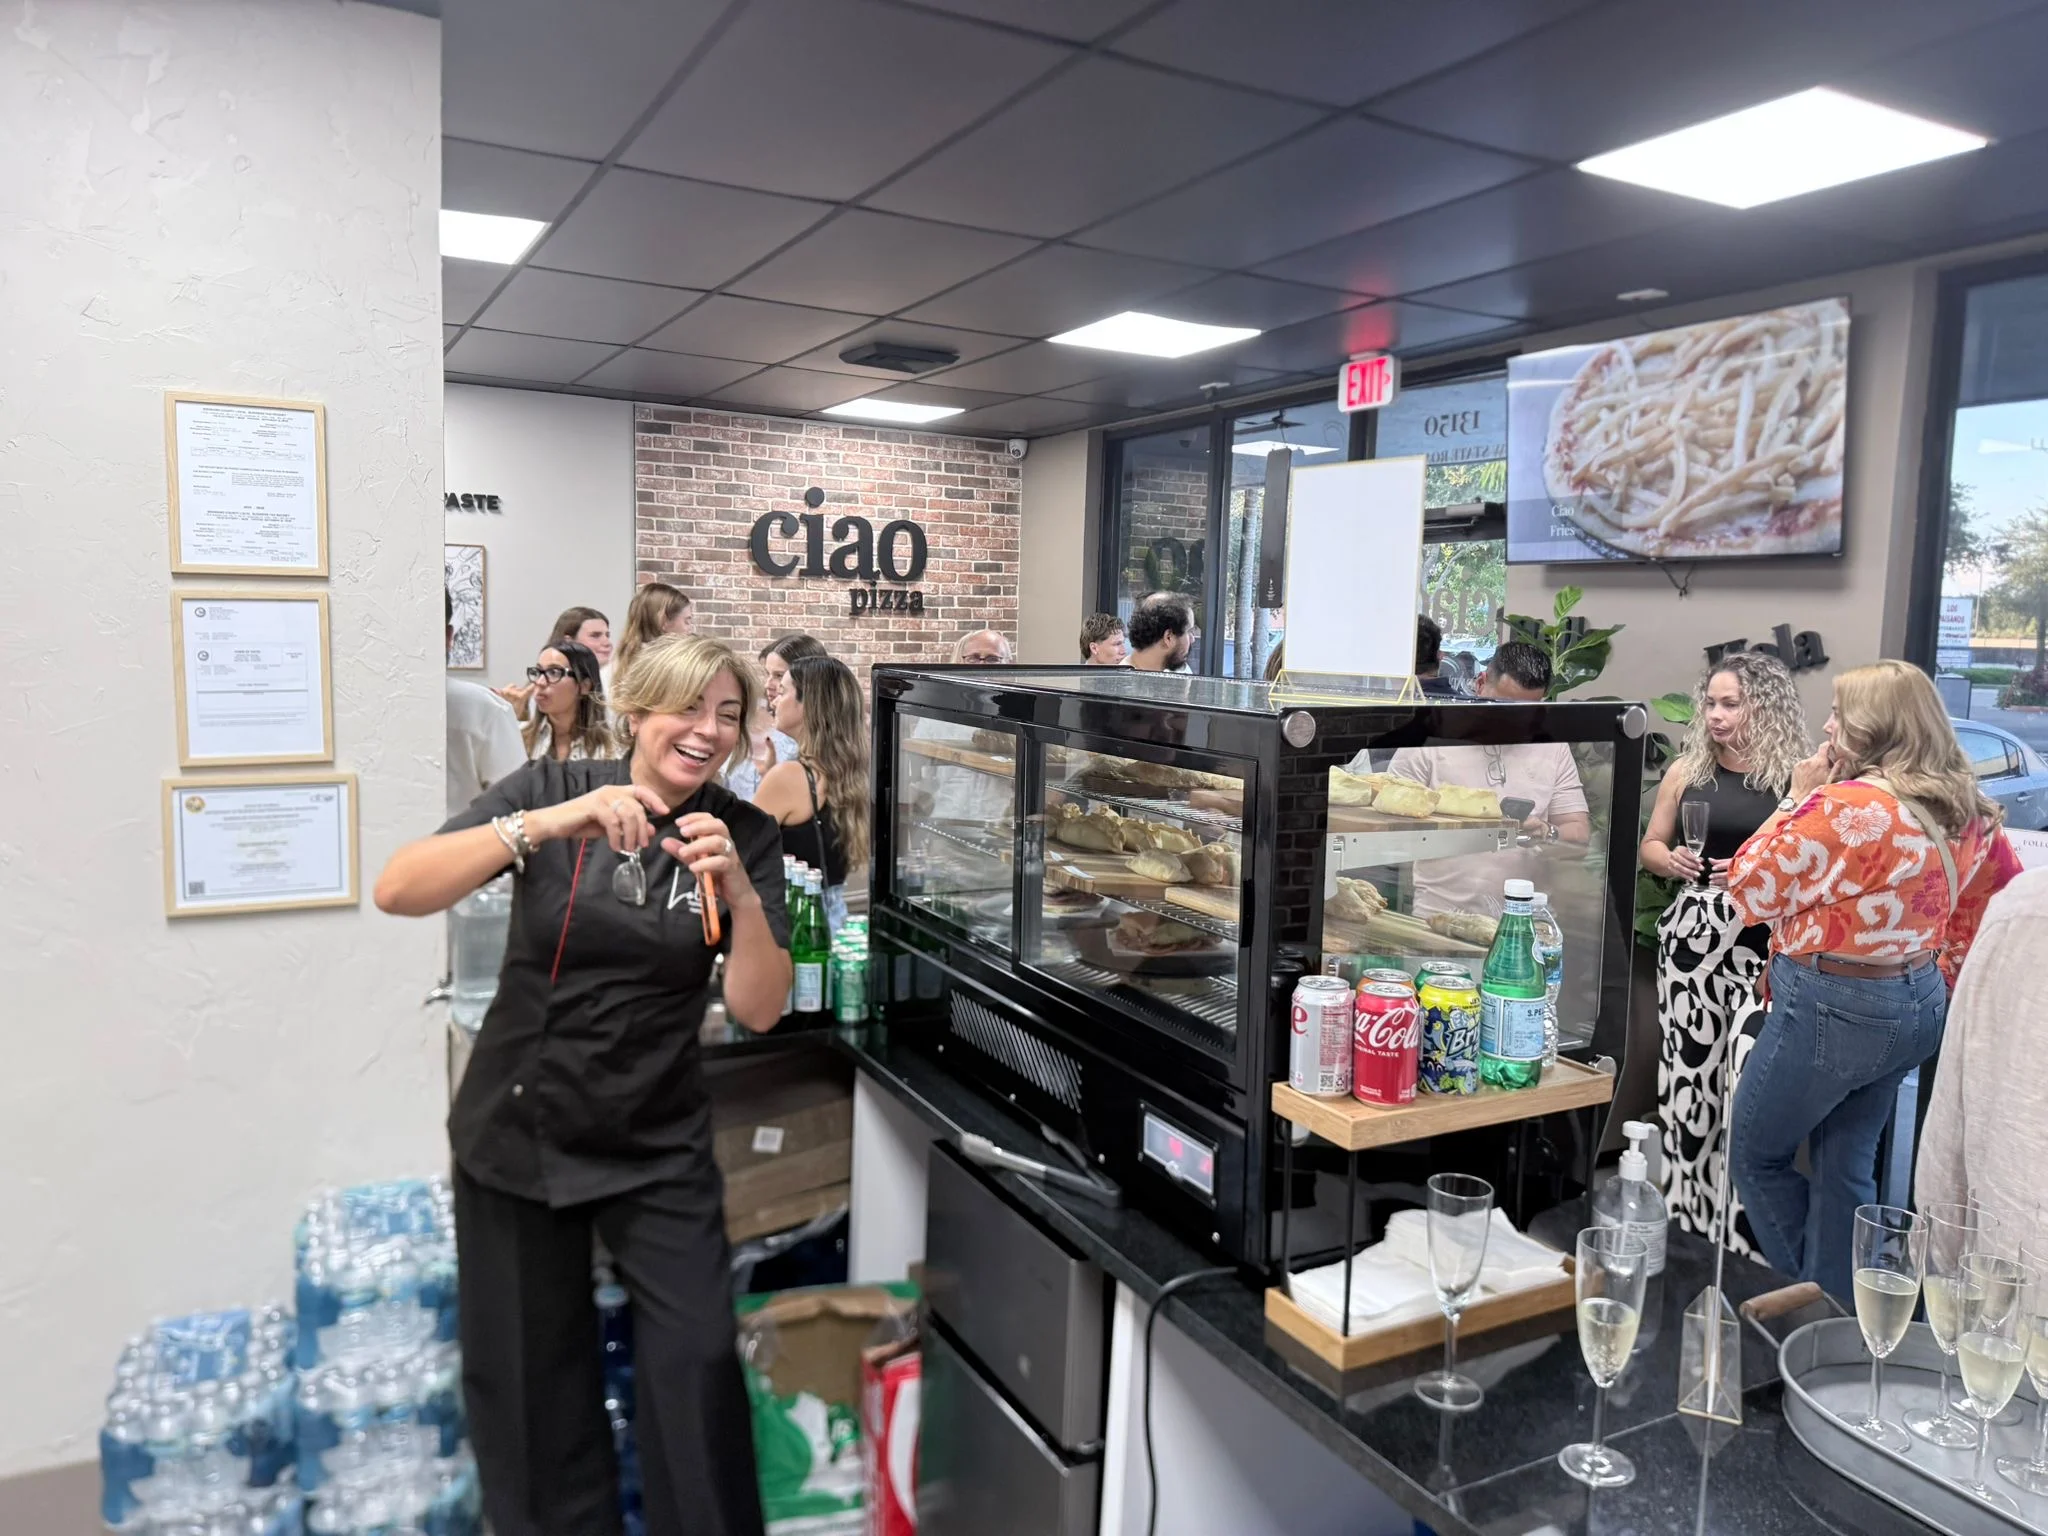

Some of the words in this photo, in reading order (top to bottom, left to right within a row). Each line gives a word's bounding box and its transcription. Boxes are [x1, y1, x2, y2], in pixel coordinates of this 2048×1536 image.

[1346, 358, 1386, 407] EXIT
[444, 492, 499, 511] ASTE
[1551, 504, 1575, 518] Ciao
[750, 487, 927, 582] ciao
[1550, 524, 1575, 537] Fries
[849, 581, 925, 616] pizza
[1377, 1050, 1400, 1058] TASTE
